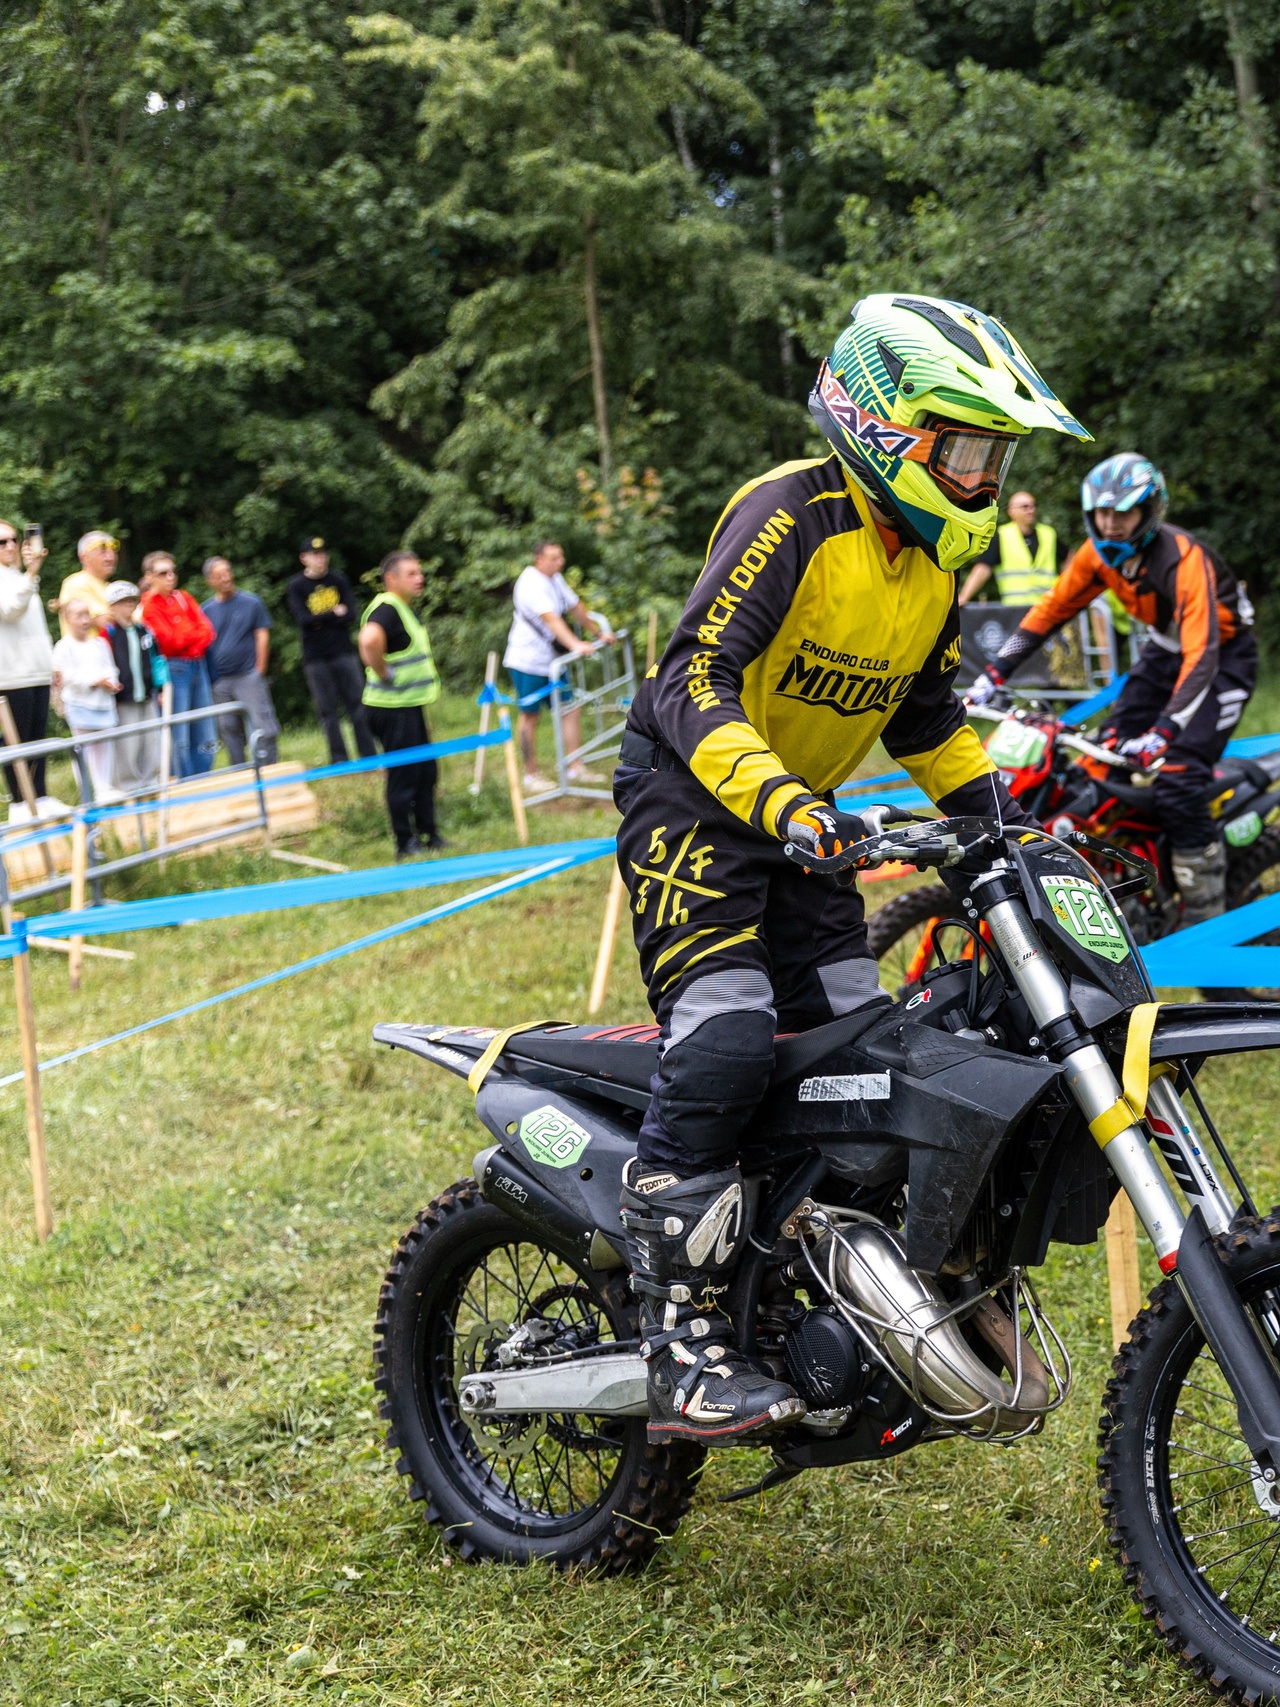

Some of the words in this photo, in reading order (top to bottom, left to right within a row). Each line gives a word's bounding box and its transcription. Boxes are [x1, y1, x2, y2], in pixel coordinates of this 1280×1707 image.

[728, 508, 796, 591] DOWN
[799, 638, 859, 668] ENDURO
[859, 658, 890, 672] CLUB
[1054, 888, 1121, 939] 126
[525, 1112, 583, 1160] 126
[525, 1136, 544, 1153] ENDURO
[540, 1149, 557, 1164] JUNIOR
[494, 1176, 529, 1204] KTM
[1199, 1162, 1219, 1192] XACT
[1145, 1446, 1156, 1488] EXCEL
